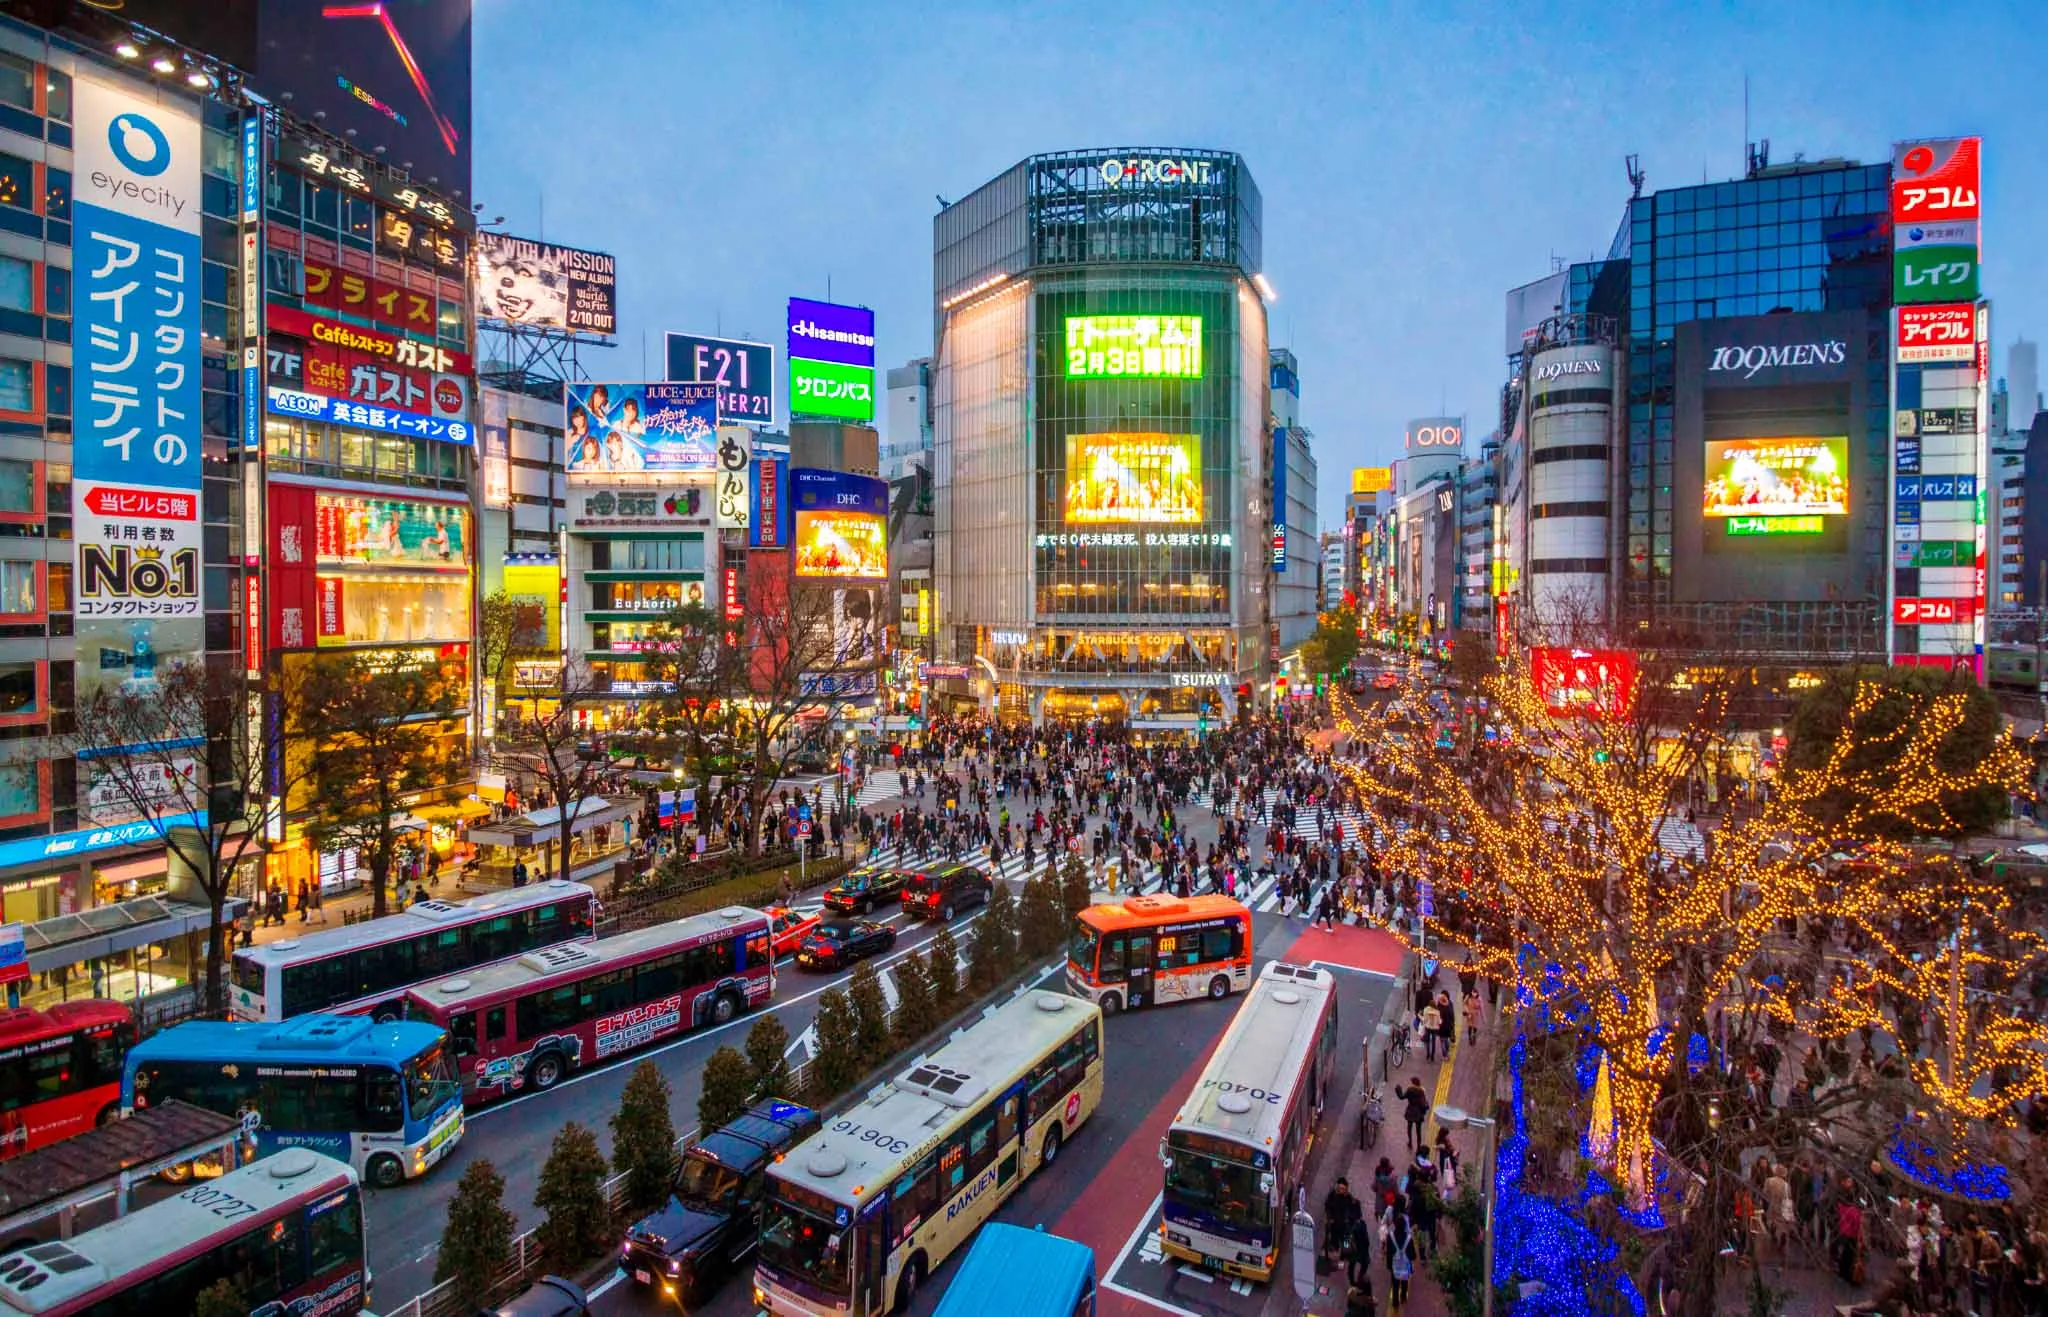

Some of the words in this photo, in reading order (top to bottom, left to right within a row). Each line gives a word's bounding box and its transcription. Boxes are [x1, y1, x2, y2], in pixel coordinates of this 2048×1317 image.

[1101, 159, 1212, 189] QFRONT
[91, 171, 186, 216] eyecity
[1902, 186, 1976, 211] アコム
[502, 236, 539, 260] WITH
[543, 246, 553, 264] A
[556, 247, 614, 273] MISSION
[570, 270, 587, 282] NEW
[588, 273, 613, 286] ALBUM
[1904, 262, 1971, 286] レイク
[304, 266, 431, 323] プライス
[570, 310, 592, 327] 2/10
[594, 314, 613, 329] OUT
[1903, 321, 1970, 341] アイフル
[90, 231, 142, 461] アイシティ
[791, 320, 874, 347] Hisamitsu
[153, 248, 188, 466] コンタクトの
[312, 322, 394, 356] Caféレストラン
[396, 339, 454, 373] ガスト
[1709, 340, 1846, 379] 109MEN'S
[267, 350, 302, 376] 7F
[308, 358, 345, 379] Café
[350, 365, 425, 407] ガスト
[795, 376, 871, 403] サロンパス
[276, 394, 320, 415] AEON
[333, 402, 444, 436] 英会話イーオン
[752, 396, 769, 415] 21
[719, 437, 748, 525] もんじゃ
[100, 492, 189, 517] 当ビル5階
[836, 493, 860, 505] DHC
[104, 524, 175, 542] 利用者数
[1273, 523, 1285, 564] SEIBU
[80, 543, 199, 598] No.1
[79, 600, 199, 614] コンタクトショップ
[1900, 603, 1952, 618] アコム
[1078, 635, 1140, 646] STARBUCKS
[596, 995, 681, 1036] ヨドバシカメラ
[1203, 1079, 1282, 1105] 20404
[242, 1115, 258, 1131] 14
[832, 1121, 909, 1155] 30616
[180, 1185, 258, 1219] 30727
[946, 1167, 997, 1223] RAKUEN
